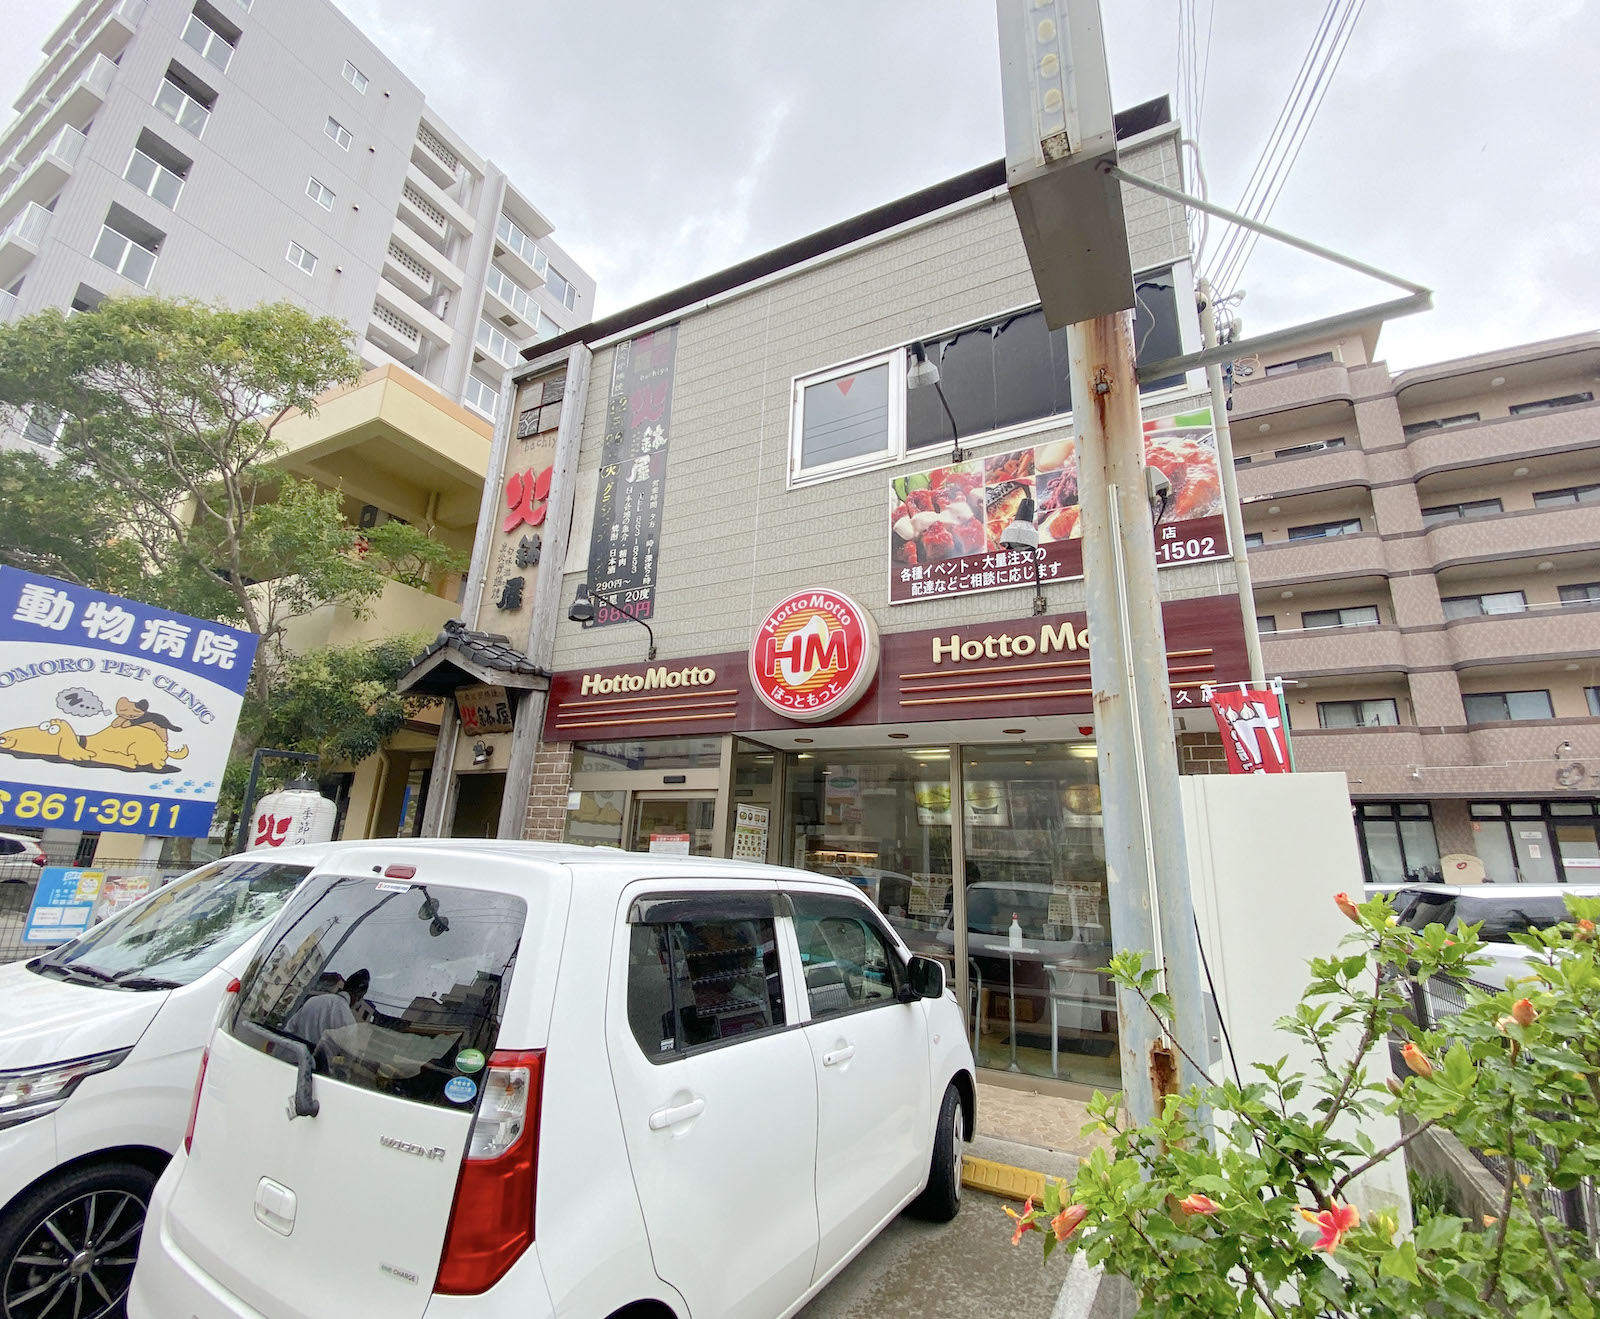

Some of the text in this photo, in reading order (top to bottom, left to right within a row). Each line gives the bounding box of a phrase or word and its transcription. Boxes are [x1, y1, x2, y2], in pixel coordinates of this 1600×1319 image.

[524, 435, 557, 453] bachiy
[649, 480, 660, 509] 営業時間
[900, 548, 1047, 583] 各種イベント・大量注文の
[911, 561, 1062, 596] 配達などご相談に応じます
[597, 601, 651, 624] 980円
[625, 589, 649, 602] 20度
[12, 583, 239, 671] 動物病院
[764, 628, 850, 679] HM
[100, 657, 151, 682] PET
[152, 673, 216, 726] CLINIC
[770, 681, 843, 708] ほっともっと
[460, 702, 511, 728] 火鉢屋
[14, 790, 181, 830] 861-3911
[295, 807, 313, 846] 季節の
[254, 813, 293, 848] 火
[392, 1269, 416, 1283] CHARGE
